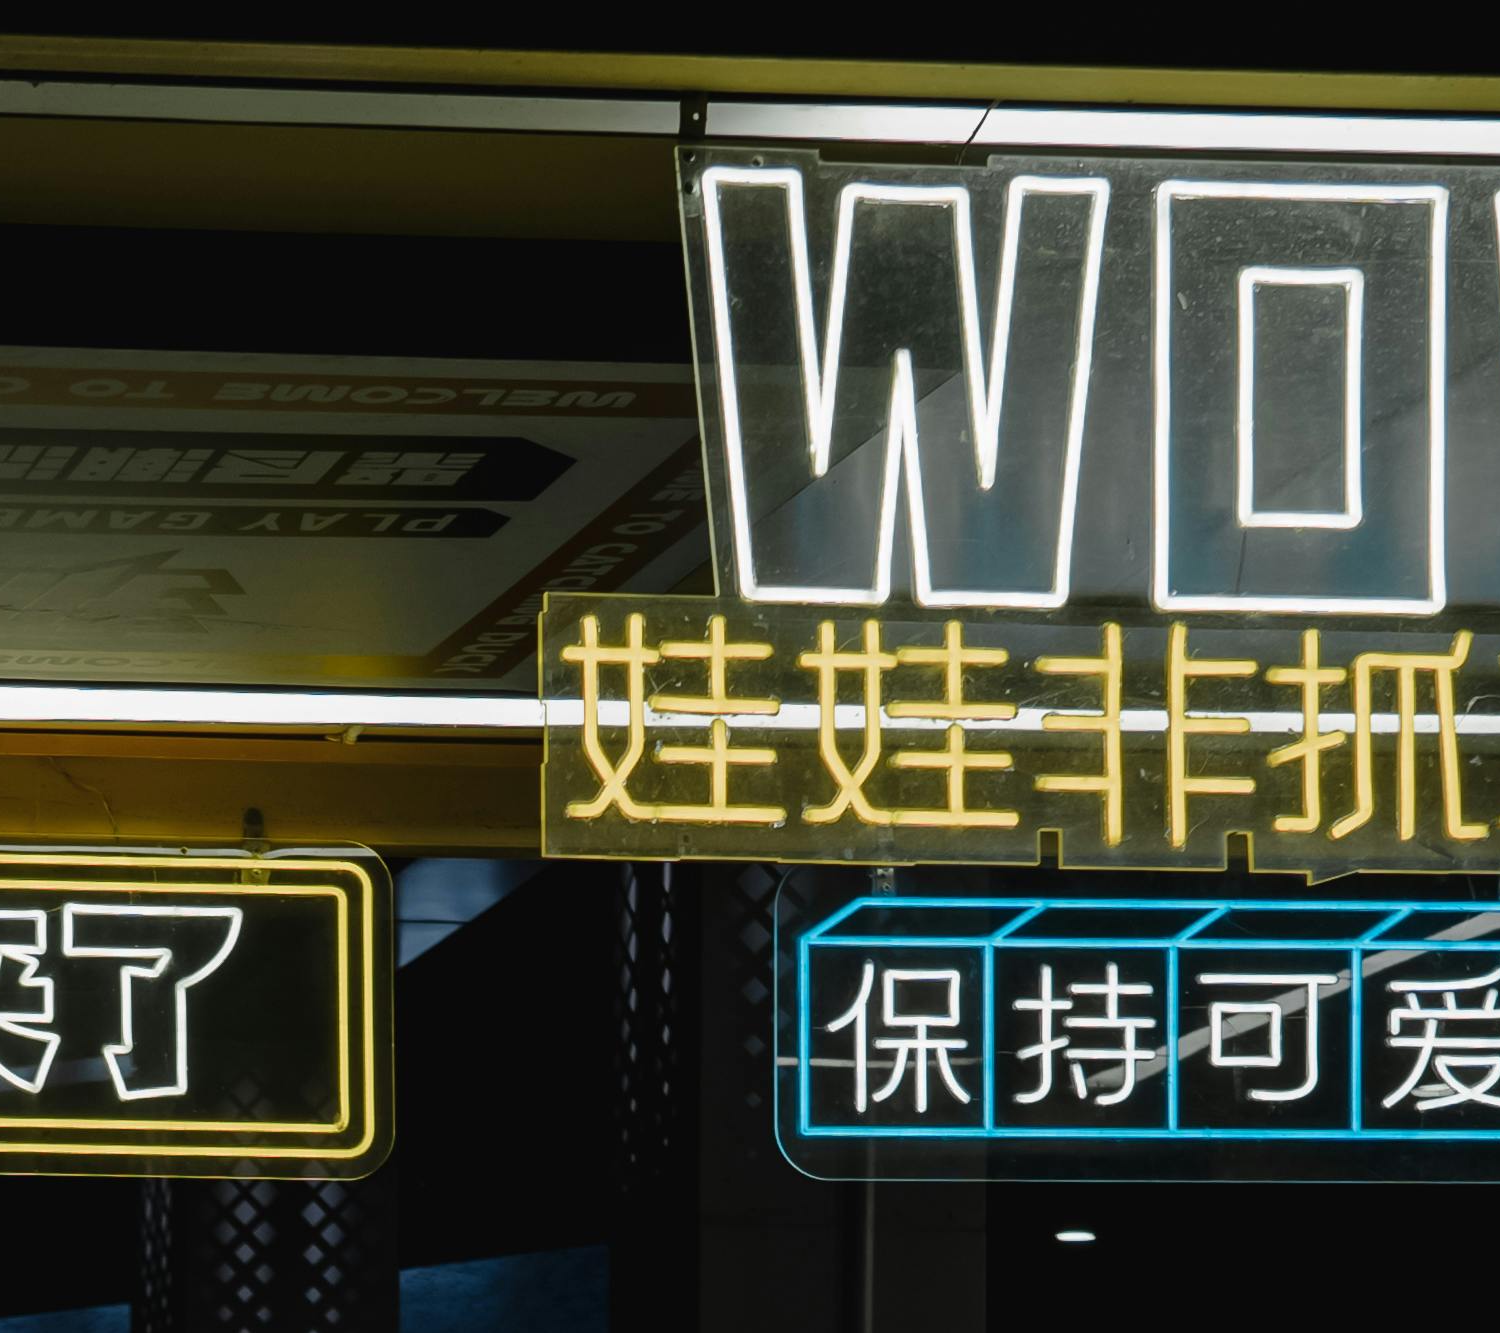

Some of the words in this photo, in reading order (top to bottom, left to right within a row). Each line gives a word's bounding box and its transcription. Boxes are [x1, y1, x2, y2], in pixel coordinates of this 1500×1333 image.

[67, 374, 177, 398] TO
[213, 380, 637, 409] WELCOME
[244, 511, 460, 535] PLAY
